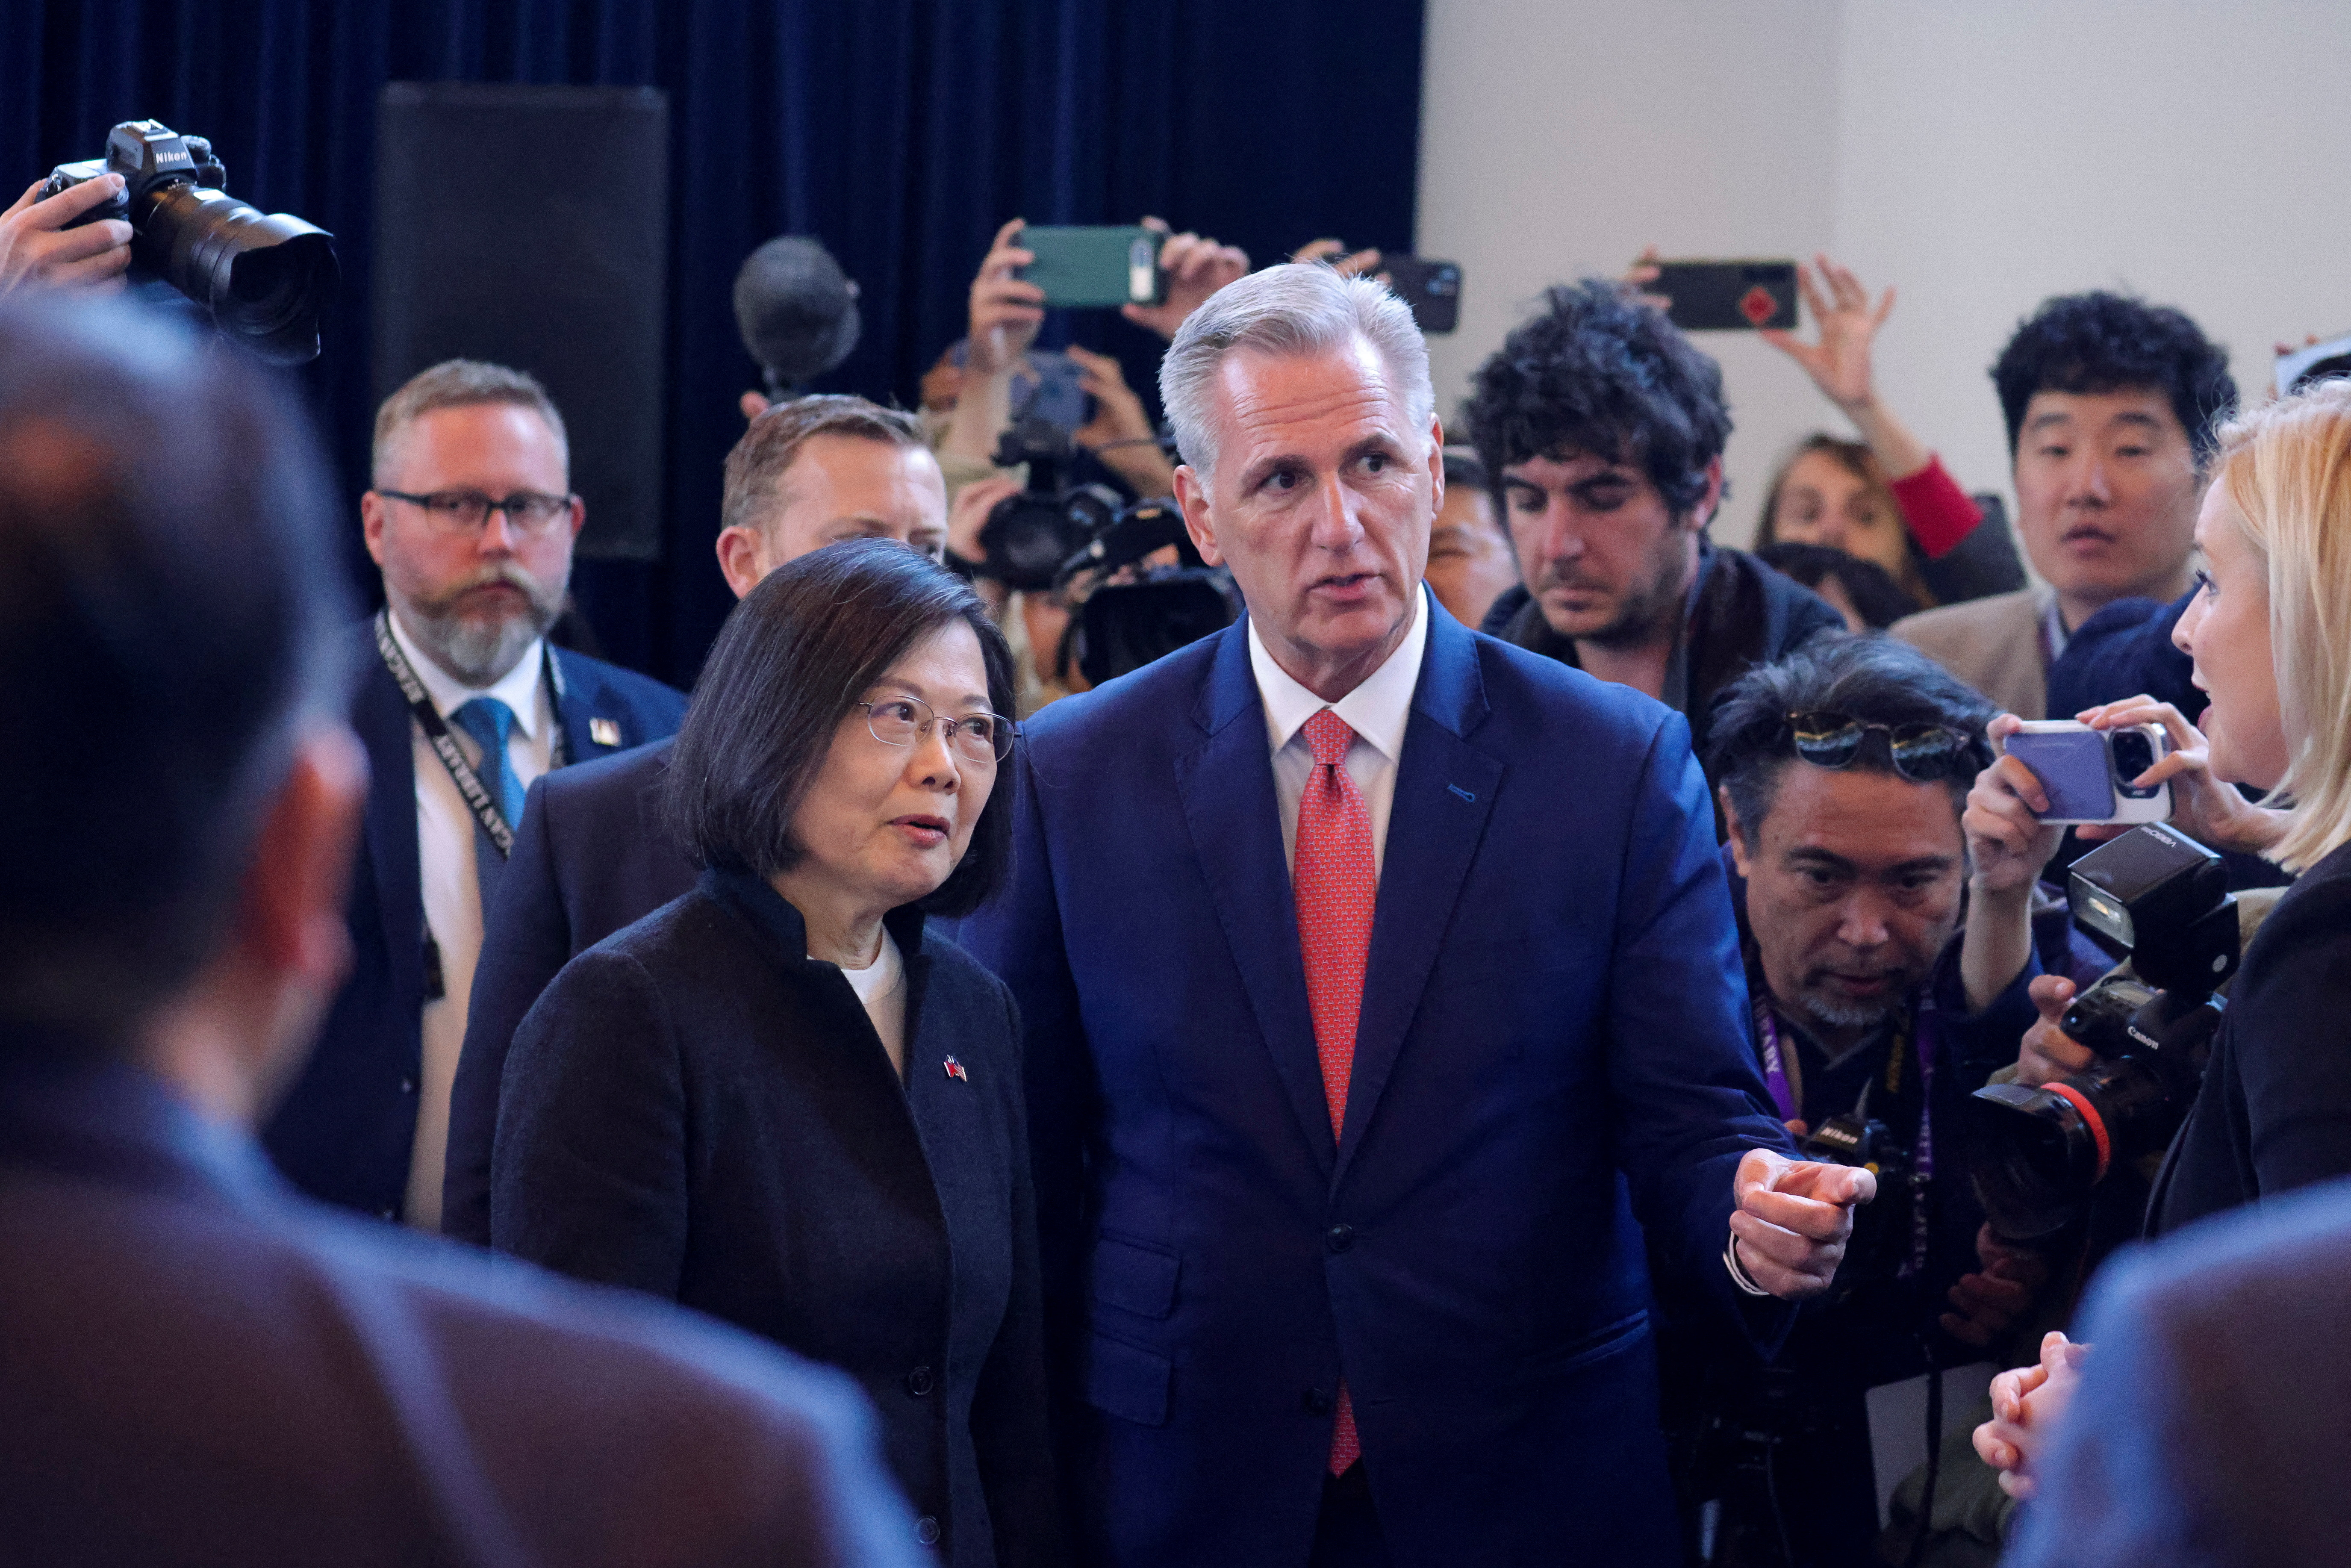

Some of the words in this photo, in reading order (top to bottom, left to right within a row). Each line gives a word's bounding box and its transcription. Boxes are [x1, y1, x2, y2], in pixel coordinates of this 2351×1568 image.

[156, 151, 187, 164] Nikon
[433, 734, 490, 810] LIBRARY
[478, 806, 514, 856] GAN
[2127, 1026, 2159, 1049] Canon
[1821, 1127, 1858, 1144] Nikon
